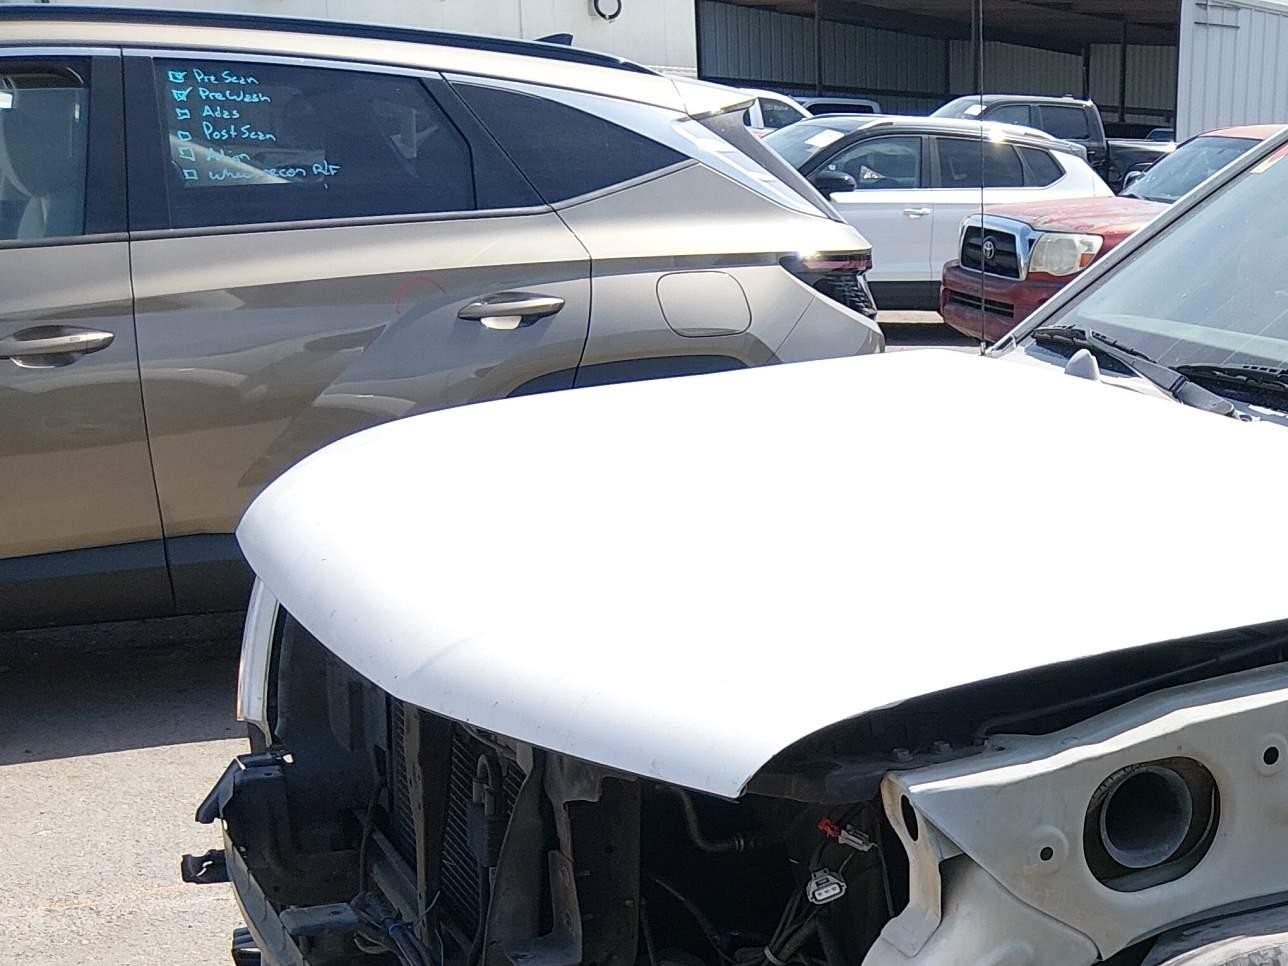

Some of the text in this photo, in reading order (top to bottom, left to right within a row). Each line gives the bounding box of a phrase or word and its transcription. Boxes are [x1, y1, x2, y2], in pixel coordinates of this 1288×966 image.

[192, 67, 260, 85] Pre Scan
[202, 121, 277, 142] Post Scan
